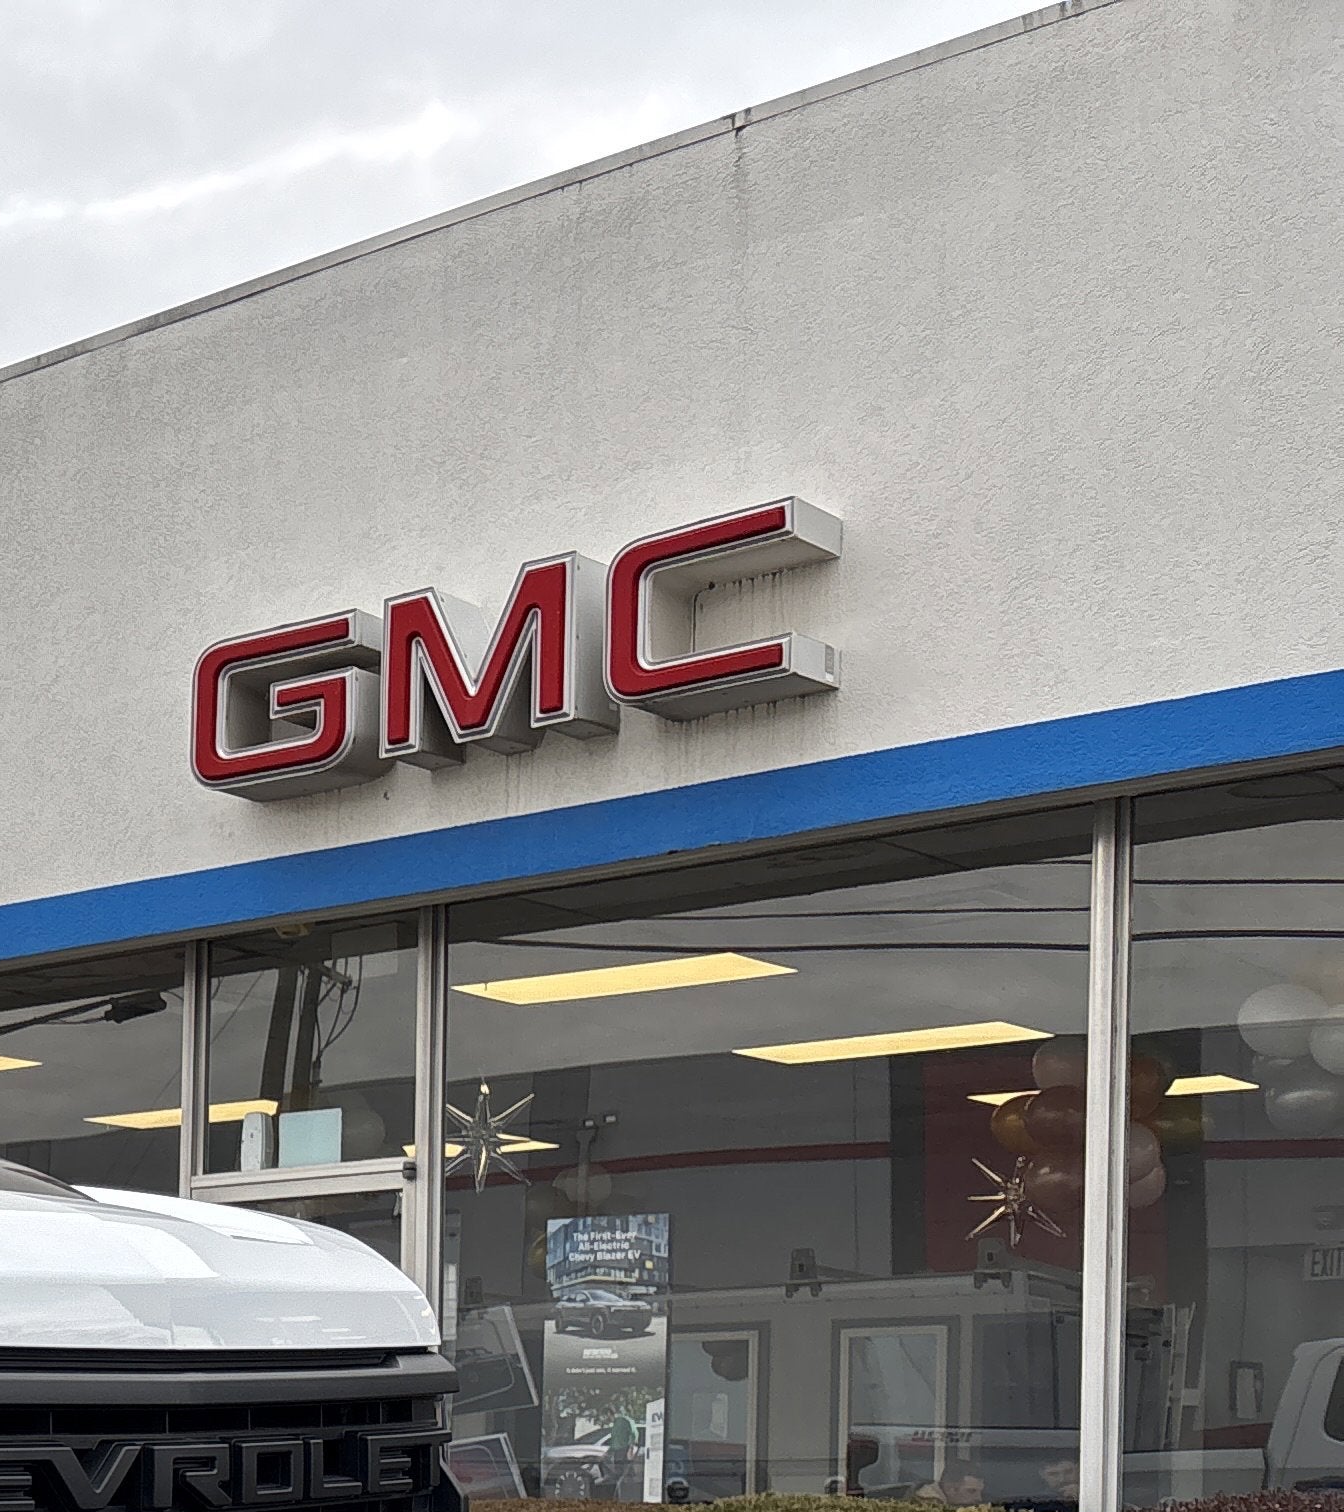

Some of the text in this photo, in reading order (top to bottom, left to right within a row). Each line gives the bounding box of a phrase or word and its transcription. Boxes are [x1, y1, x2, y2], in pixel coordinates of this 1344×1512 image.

[190, 496, 812, 792] GMC
[573, 1232, 588, 1242] The
[578, 1241, 630, 1251] All-Electric
[569, 1249, 641, 1262] Chevy Blazer EV
